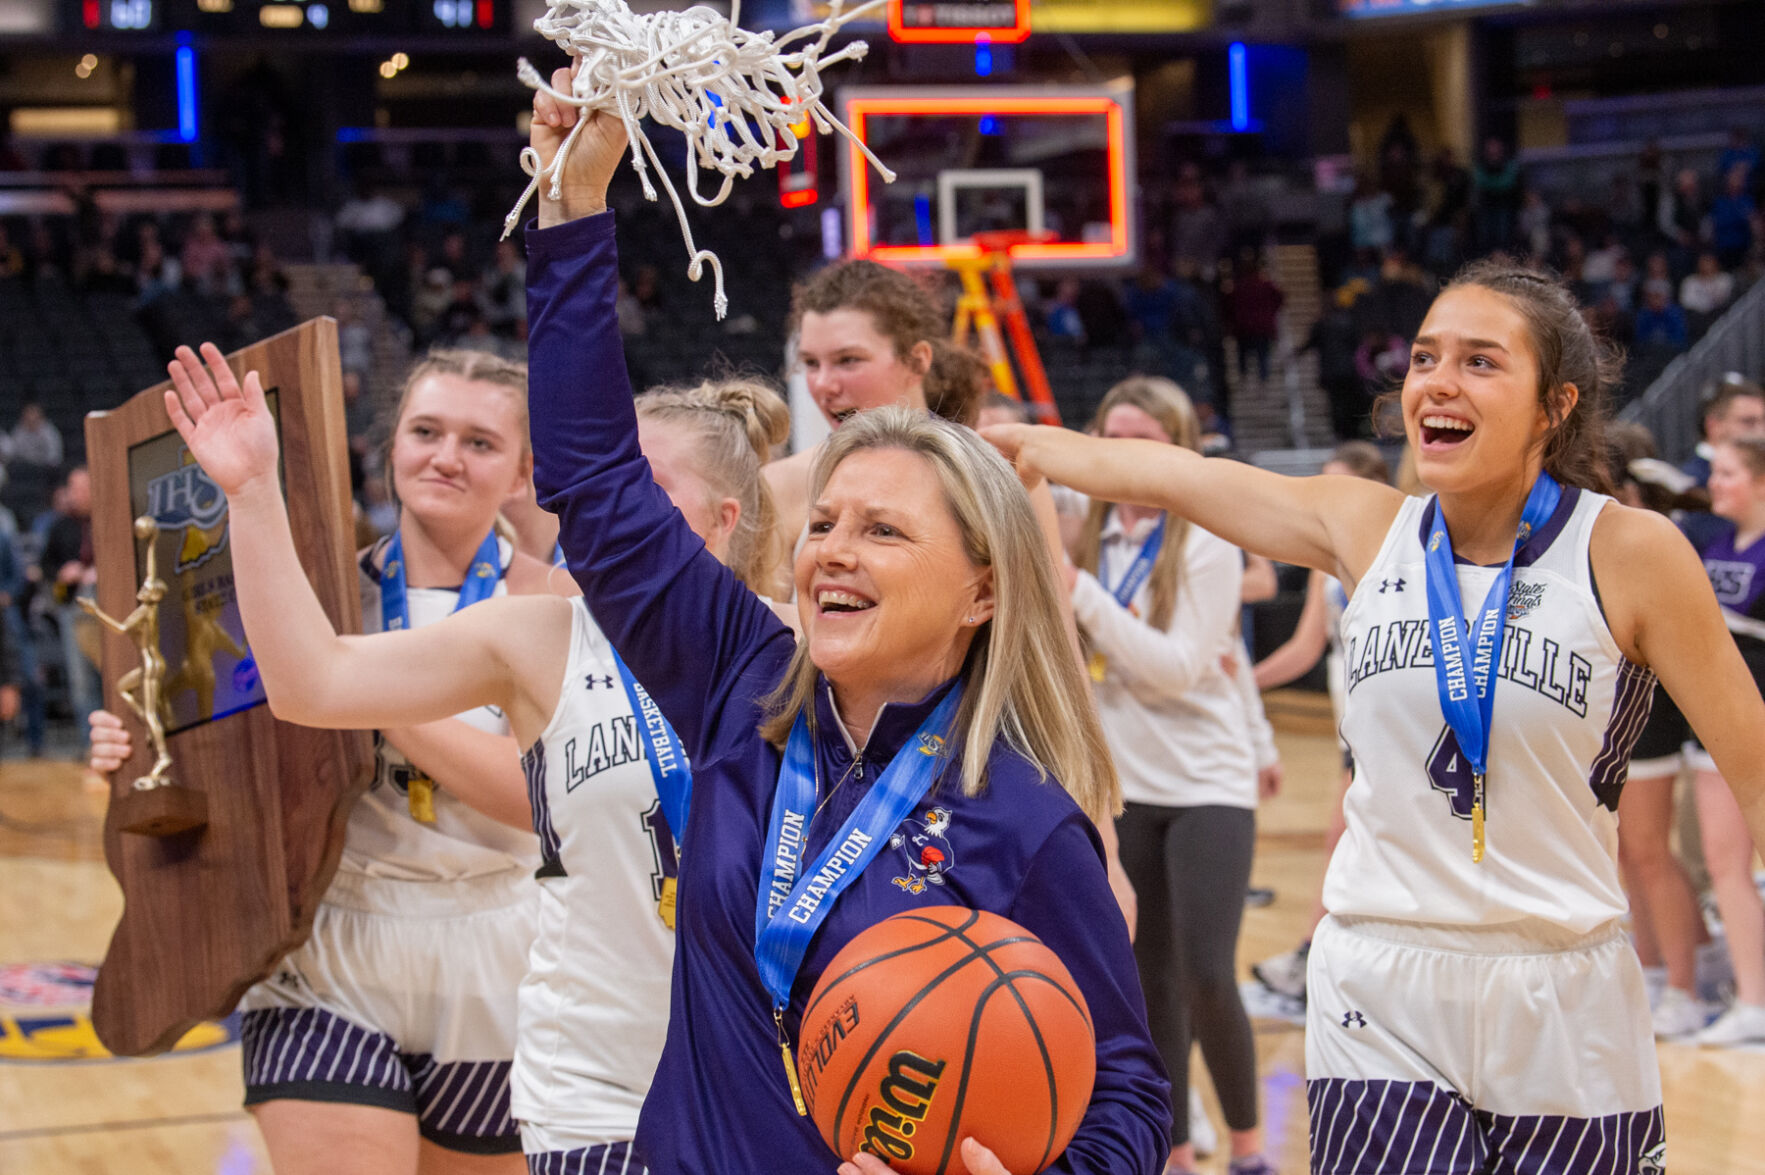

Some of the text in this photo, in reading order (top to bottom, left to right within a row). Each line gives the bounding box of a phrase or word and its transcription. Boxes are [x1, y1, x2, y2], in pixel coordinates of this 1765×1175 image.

[1348, 619, 1593, 720] LANEILLE
[1438, 615, 1468, 702] CHAMPION
[1472, 607, 1500, 699] CHAMPION
[565, 714, 650, 795] LAN
[632, 682, 678, 779] BASKETBALL
[1425, 722, 1487, 821] 4
[788, 827, 873, 924] CHAMPION
